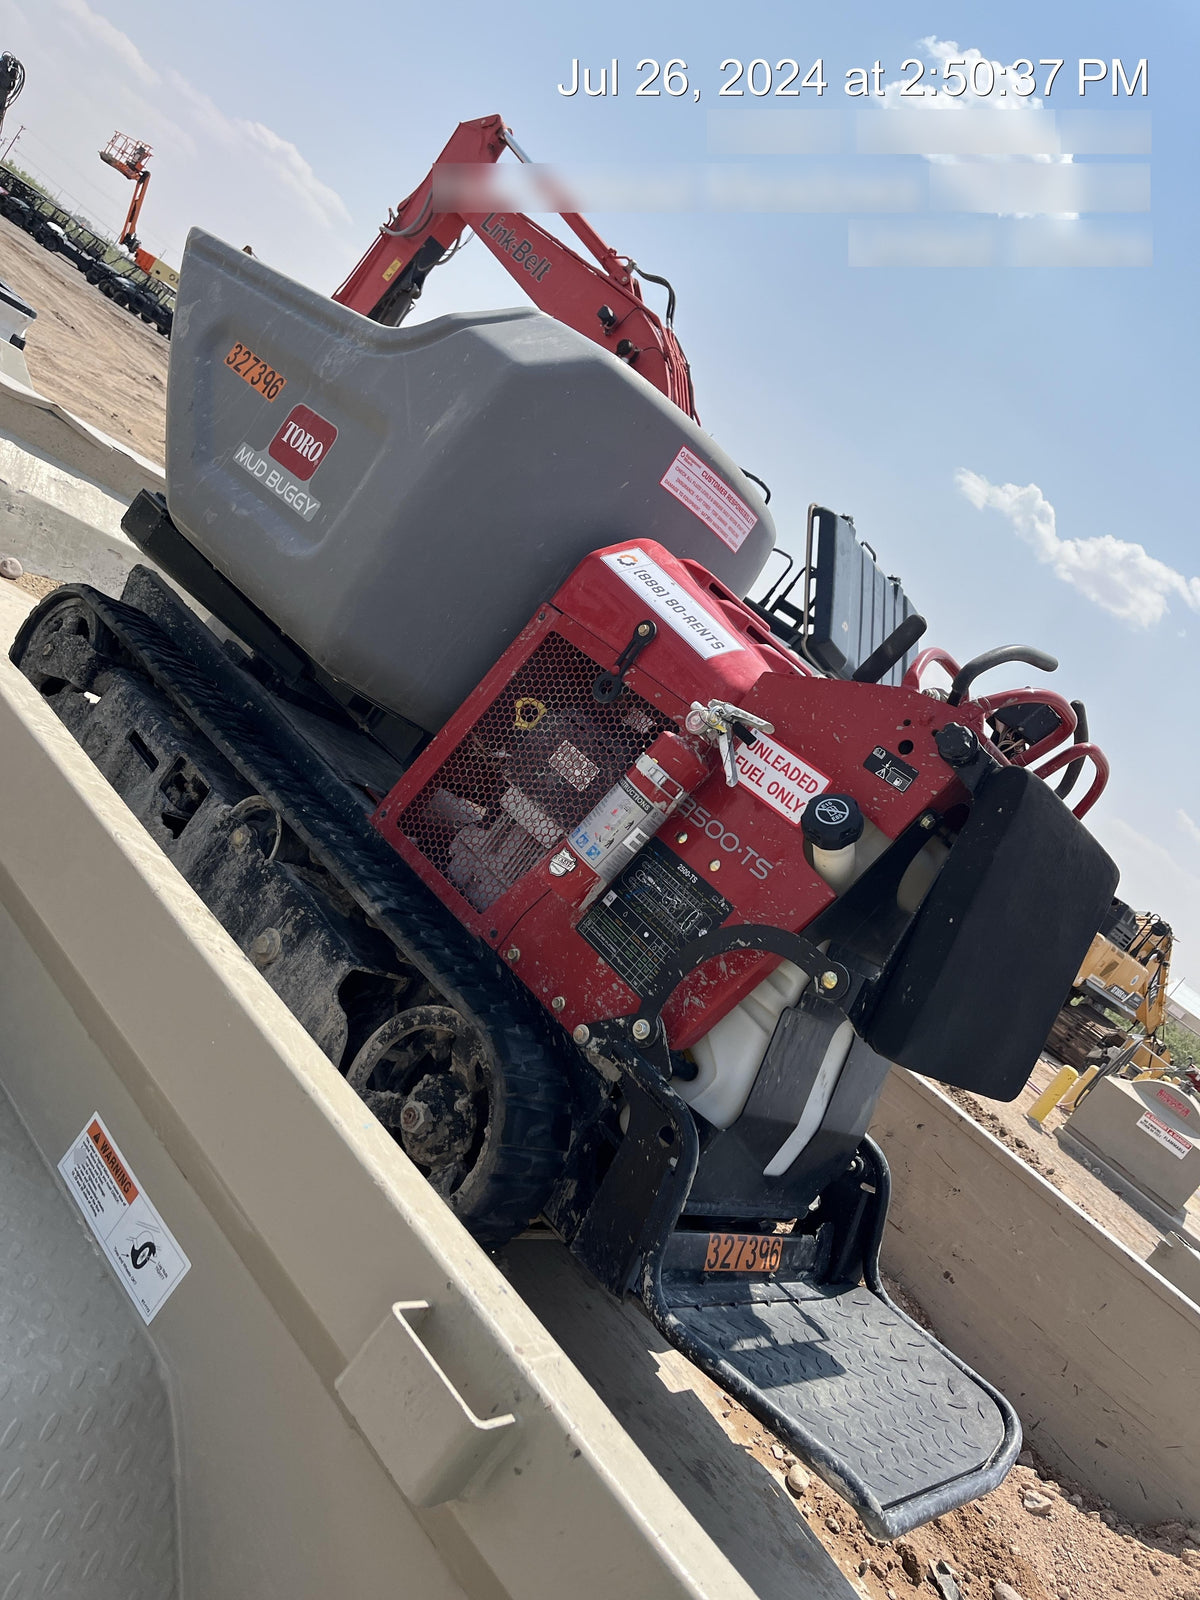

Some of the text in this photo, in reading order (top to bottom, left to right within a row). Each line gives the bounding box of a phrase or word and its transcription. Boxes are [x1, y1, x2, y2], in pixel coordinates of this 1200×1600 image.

[226, 344, 284, 400] 327396
[281, 421, 324, 462] TORO
[235, 446, 318, 516] MUD BUGGY
[701, 469, 727, 497] CUSTOMER
[724, 493, 755, 526] RESPONSIBILITY
[633, 569, 726, 650] (888) 80-RENTS
[620, 780, 651, 812] STRUCTIONS
[735, 755, 806, 813] FUEL ONLY
[98, 1140, 132, 1194] WARNING
[707, 1234, 781, 1270] 327396
